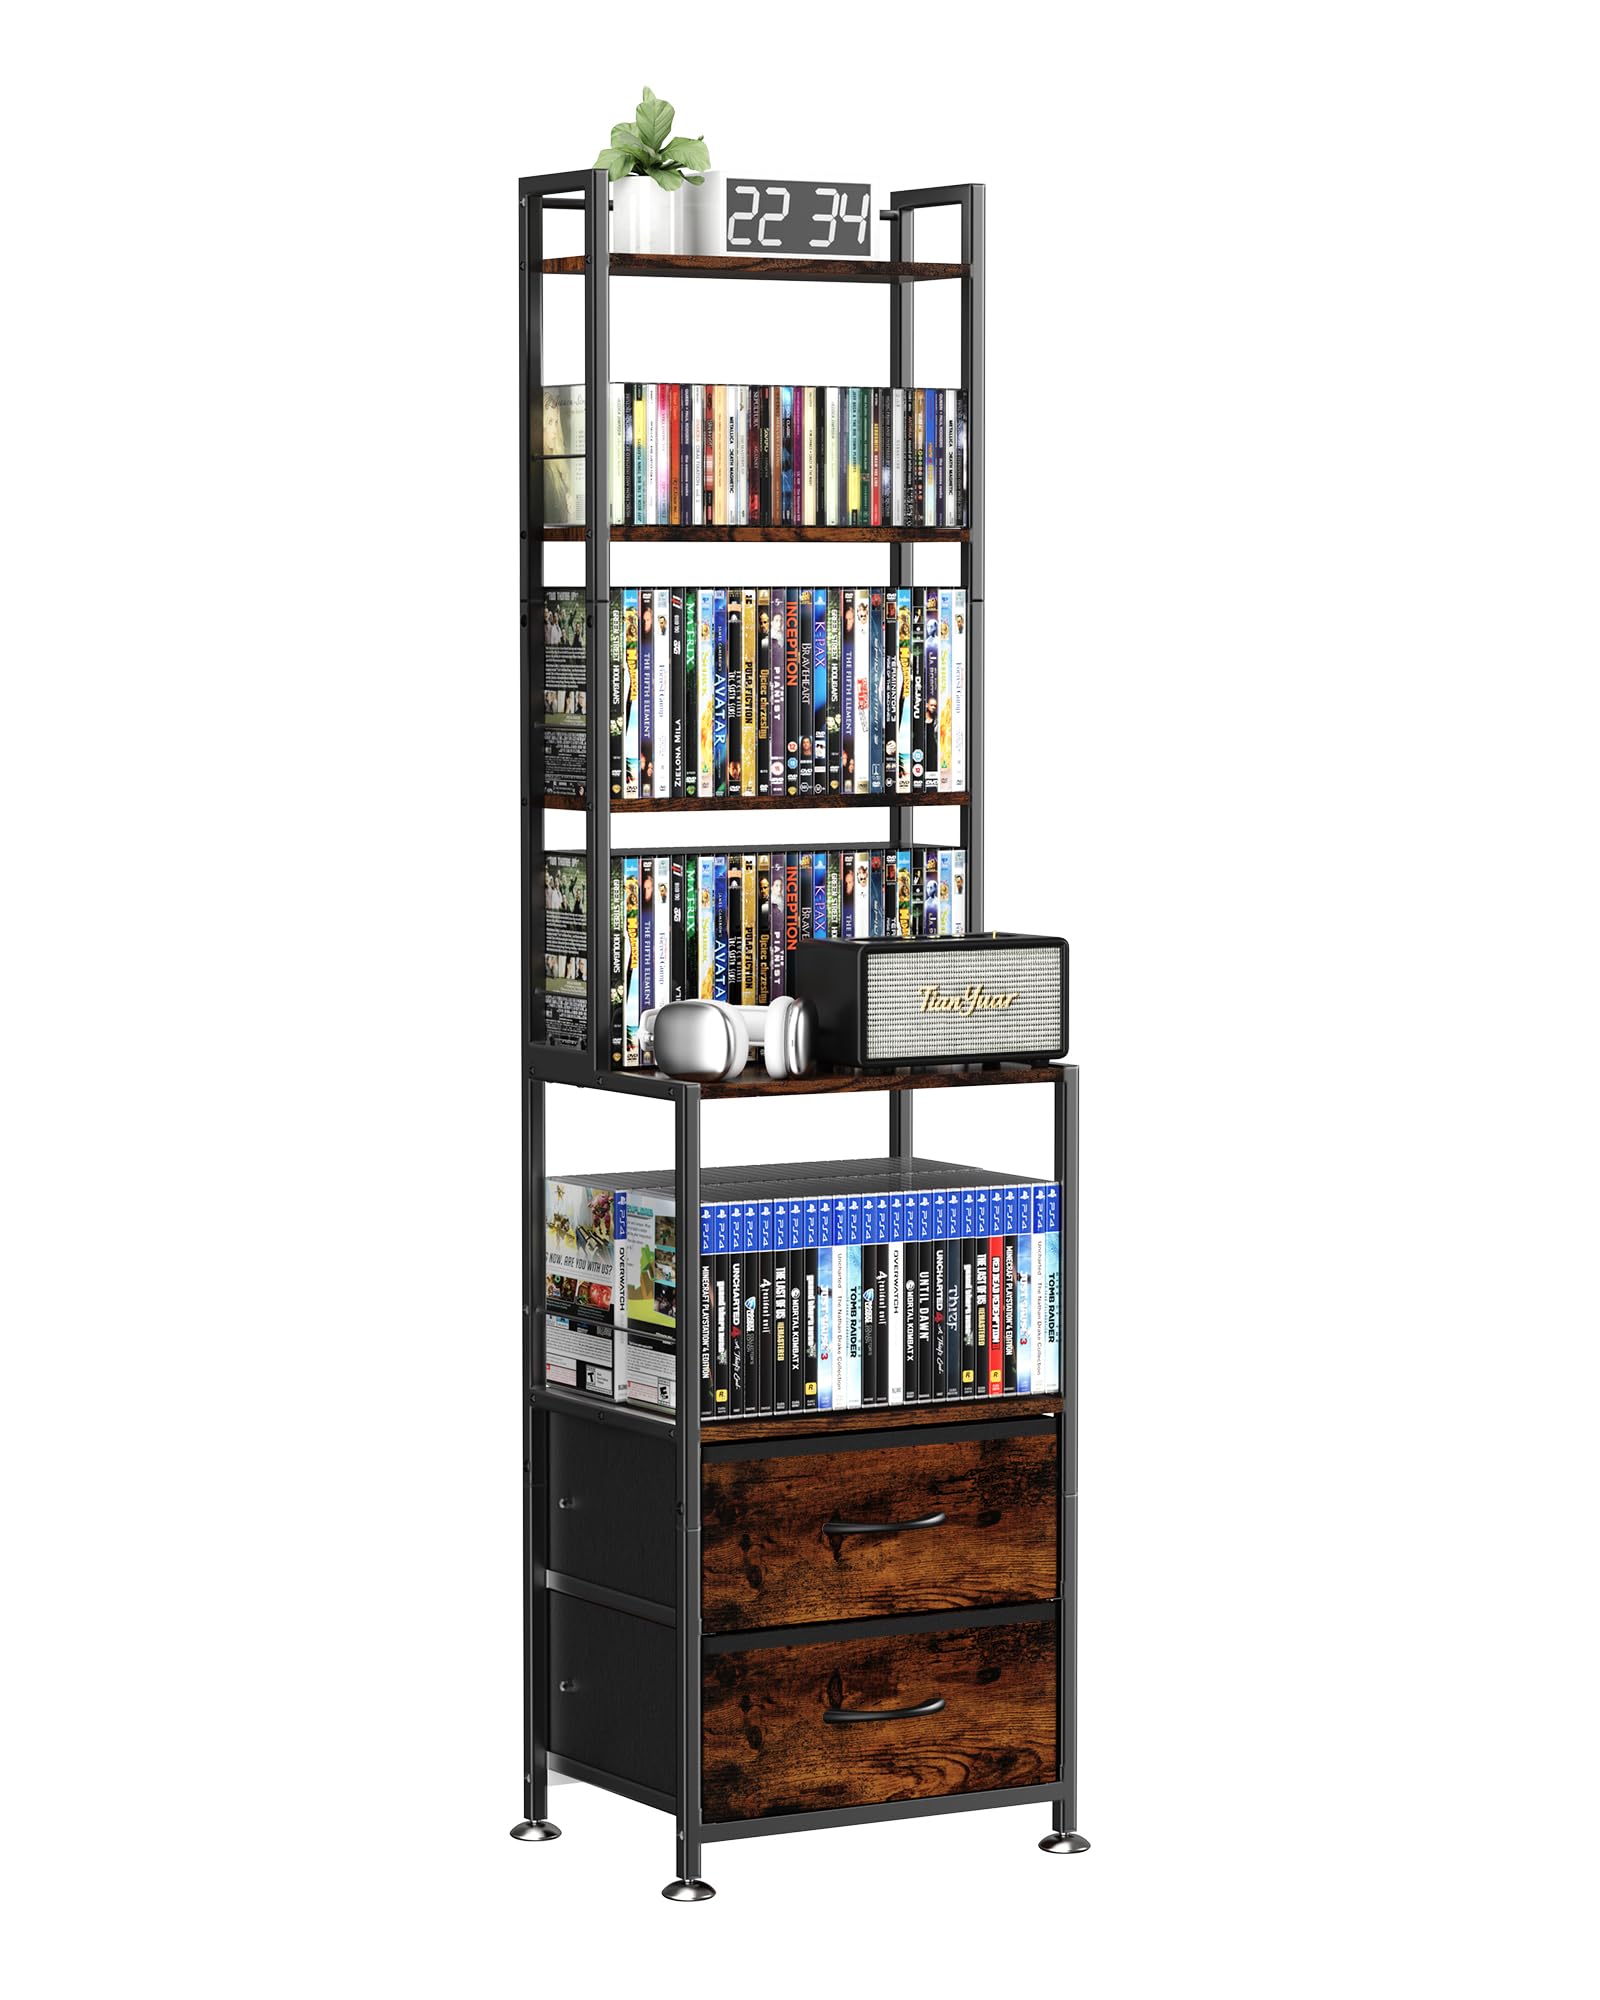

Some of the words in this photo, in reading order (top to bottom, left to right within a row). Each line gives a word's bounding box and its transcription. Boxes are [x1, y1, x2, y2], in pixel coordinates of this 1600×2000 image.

[728, 186, 790, 246] 22
[809, 188, 870, 247] 34
[612, 610, 620, 633] GREEN
[686, 602, 695, 665] MATRIX
[831, 609, 839, 632] GREEN
[612, 636, 620, 662] STREET
[787, 602, 798, 686] INCEPTION
[815, 621, 825, 669] K-PAX
[831, 634, 839, 660] STREET
[612, 665, 620, 704] HOOLIGANS
[758, 670, 769, 695] Ojciec
[801, 643, 812, 704] BRAVEHEART
[831, 663, 839, 702] HOOLIGANS
[714, 674, 726, 746] AVATAR
[745, 687, 753, 723] FICTION
[613, 879, 621, 902] GREEN
[687, 870, 695, 931] MATRIX
[613, 904, 621, 930] STREET
[786, 866, 798, 950] INCEPTION
[815, 886, 826, 931] K-PAX
[613, 934, 621, 973] HOOLIGANS
[715, 940, 726, 1002] AVATA
[745, 954, 753, 988] FICTION
[564, 1256, 574, 1268] ARE
[601, 1262, 613, 1275] US?
[977, 1254, 987, 1266] THE
[992, 1257, 1000, 1272] RED
[1005, 1246, 1014, 1281] MINECRAFT
[702, 1266, 710, 1302] MINECRAFT
[759, 1279, 772, 1288] 4
[775, 1267, 786, 1280] THE
[875, 1270, 887, 1280] 4
[936, 1250, 944, 1311] UNCHARTED
[977, 1267, 987, 1284] LAST
[992, 1274, 1000, 1293] DEAD
[775, 1281, 786, 1298] LAST
[878, 1280, 887, 1308] resident
[919, 1272, 929, 1303] UNTIL
[977, 1295, 987, 1304] US
[761, 1289, 771, 1316] resident
[775, 1309, 786, 1319] US
[761, 1320, 771, 1334] evil
[878, 1310, 887, 1325] evil
[934, 1312, 944, 1323] 4
[992, 1294, 1000, 1343] REDEMPTION
[731, 1326, 742, 1339] 4
[777, 1322, 785, 1361] REMASTERED
[1005, 1331, 1014, 1355] EDITION
[702, 1354, 710, 1378] EDITION
